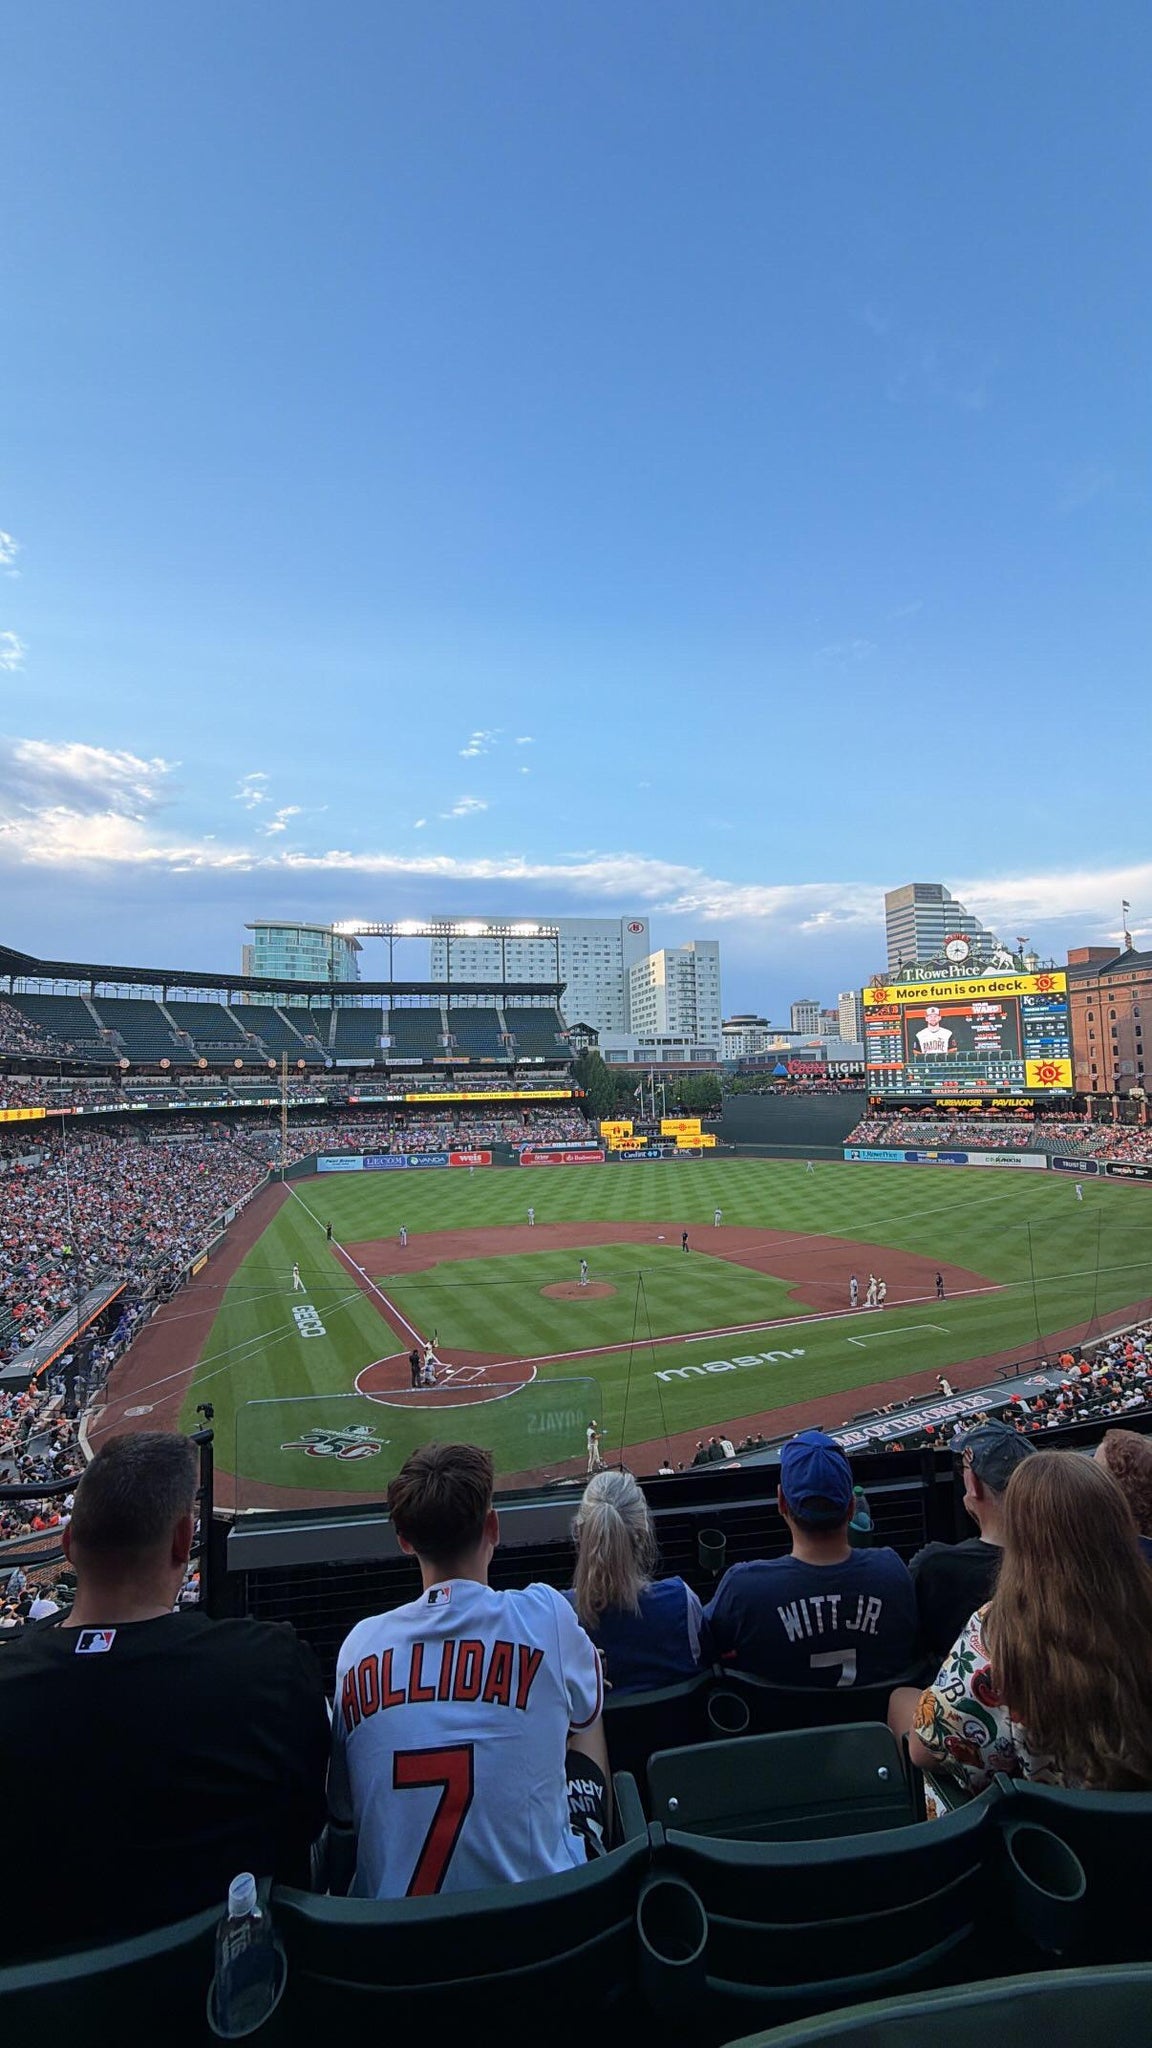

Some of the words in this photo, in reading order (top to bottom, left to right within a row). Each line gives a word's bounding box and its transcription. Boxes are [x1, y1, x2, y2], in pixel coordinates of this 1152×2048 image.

[896, 989, 928, 999] More
[930, 986, 952, 996] fun
[955, 984, 966, 994] is
[968, 985, 986, 993] on
[988, 980, 1027, 991] deck.
[787, 1059, 826, 1074] Coors
[828, 1062, 866, 1073] LIGHT
[936, 1099, 982, 1107] PUREWAGER
[992, 1098, 1034, 1107] PAVILION
[366, 1157, 402, 1165] LECOM
[418, 1156, 446, 1164] VANDA
[459, 1153, 482, 1162] weis
[292, 1305, 326, 1337] GEICO
[862, 1421, 892, 1438] OF
[887, 1413, 925, 1431] THE
[922, 1394, 992, 1422] ORIOLES
[777, 1594, 842, 1642] WITT
[845, 1594, 882, 1636] JR.
[810, 1648, 857, 1687] 7
[341, 1639, 544, 1733] HOLLIDAY
[393, 1743, 474, 1897] 7
